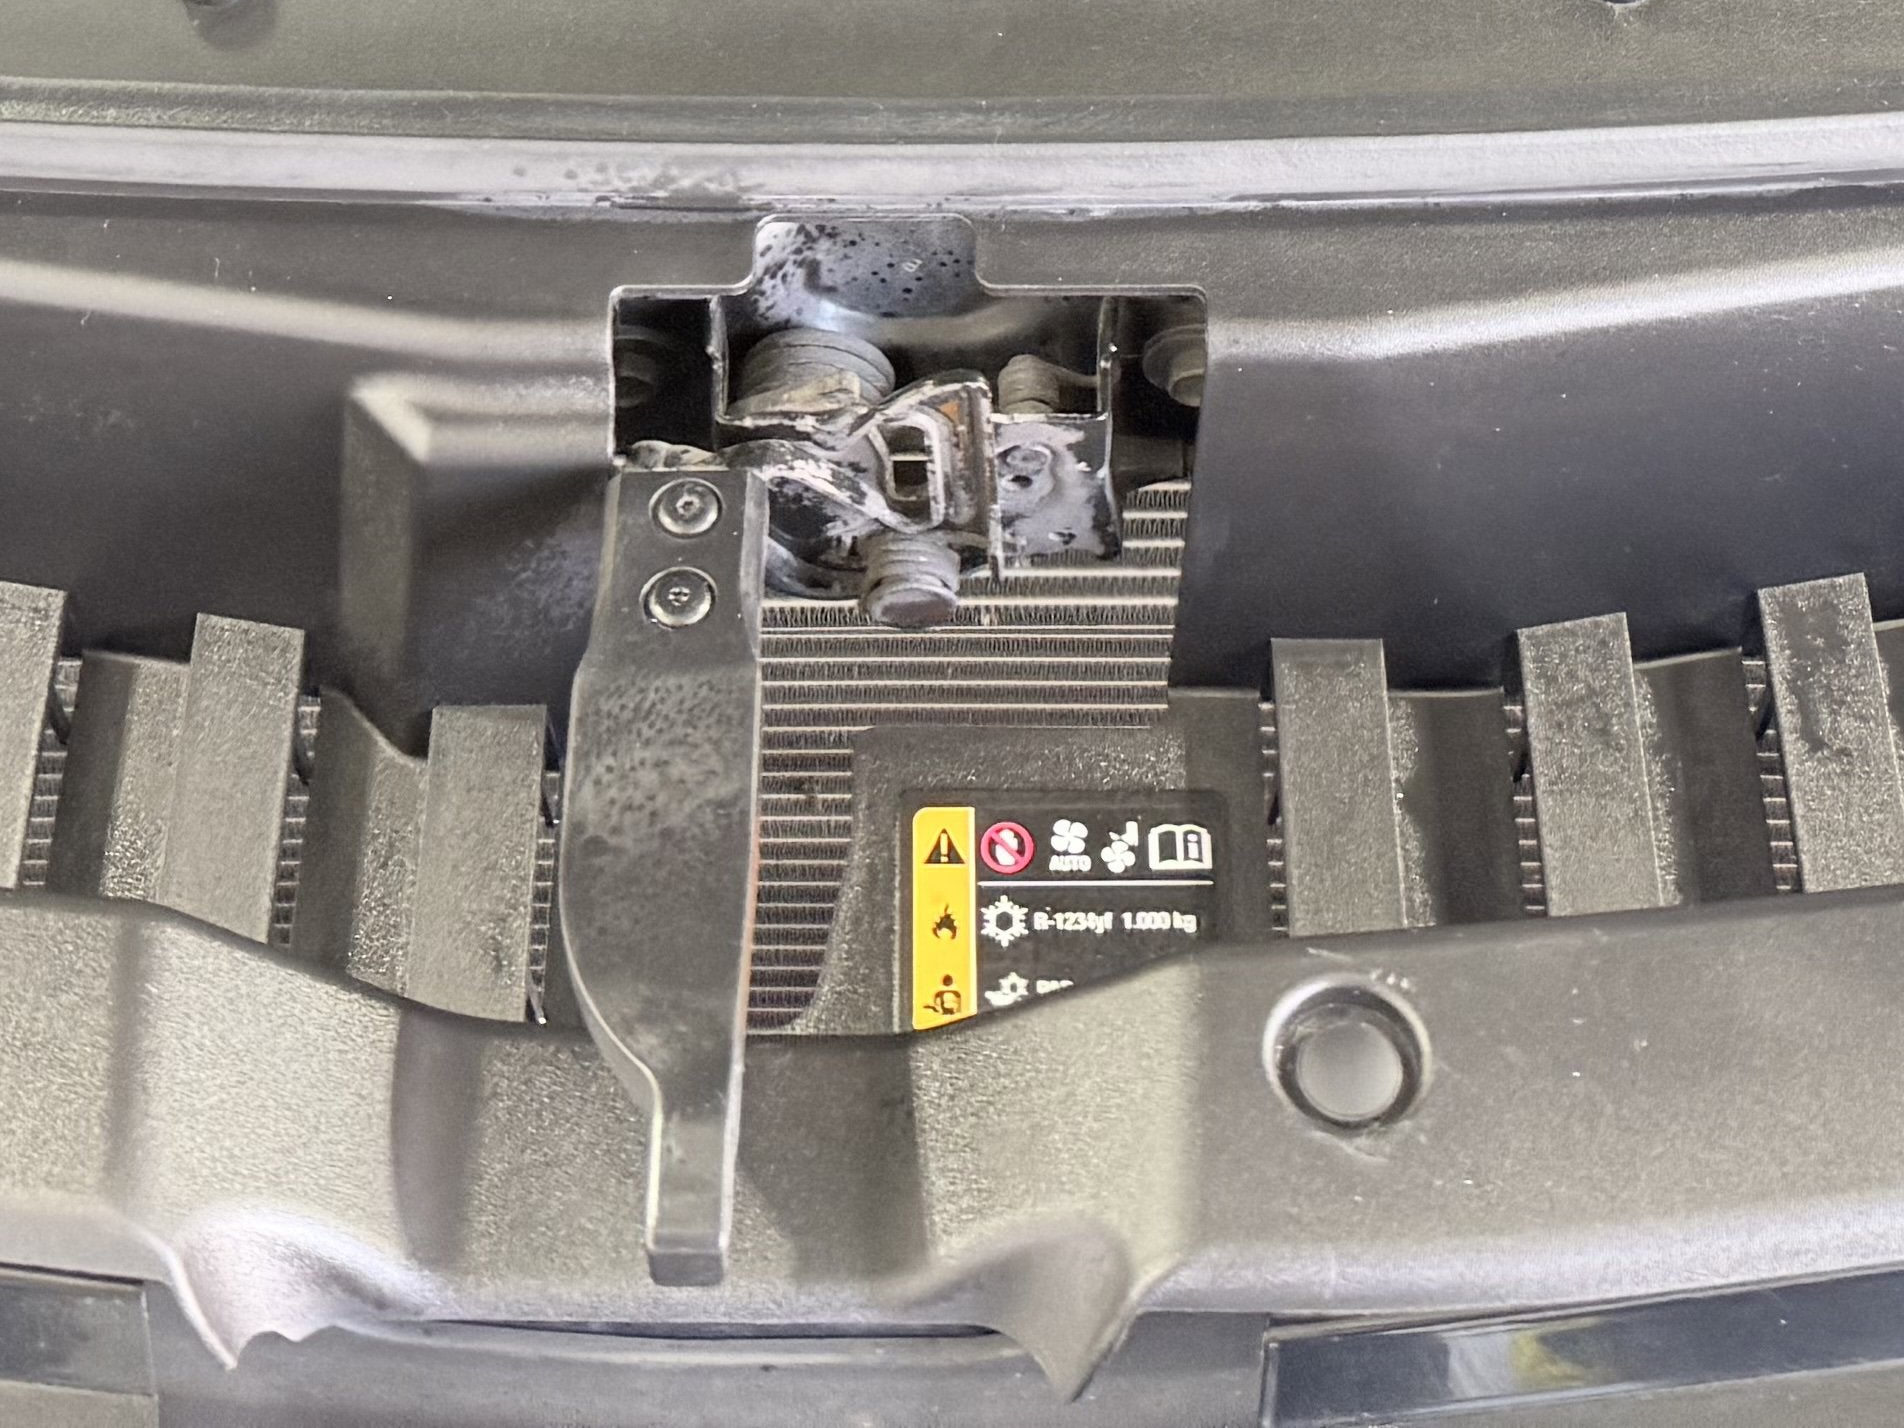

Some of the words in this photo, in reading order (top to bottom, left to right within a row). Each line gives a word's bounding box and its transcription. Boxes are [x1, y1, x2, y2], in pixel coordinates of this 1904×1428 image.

[1049, 855, 1092, 872] AUTO
[1033, 911, 1113, 934] R-1234yf
[1121, 911, 1171, 930] 1.000
[1172, 910, 1197, 933] kg
